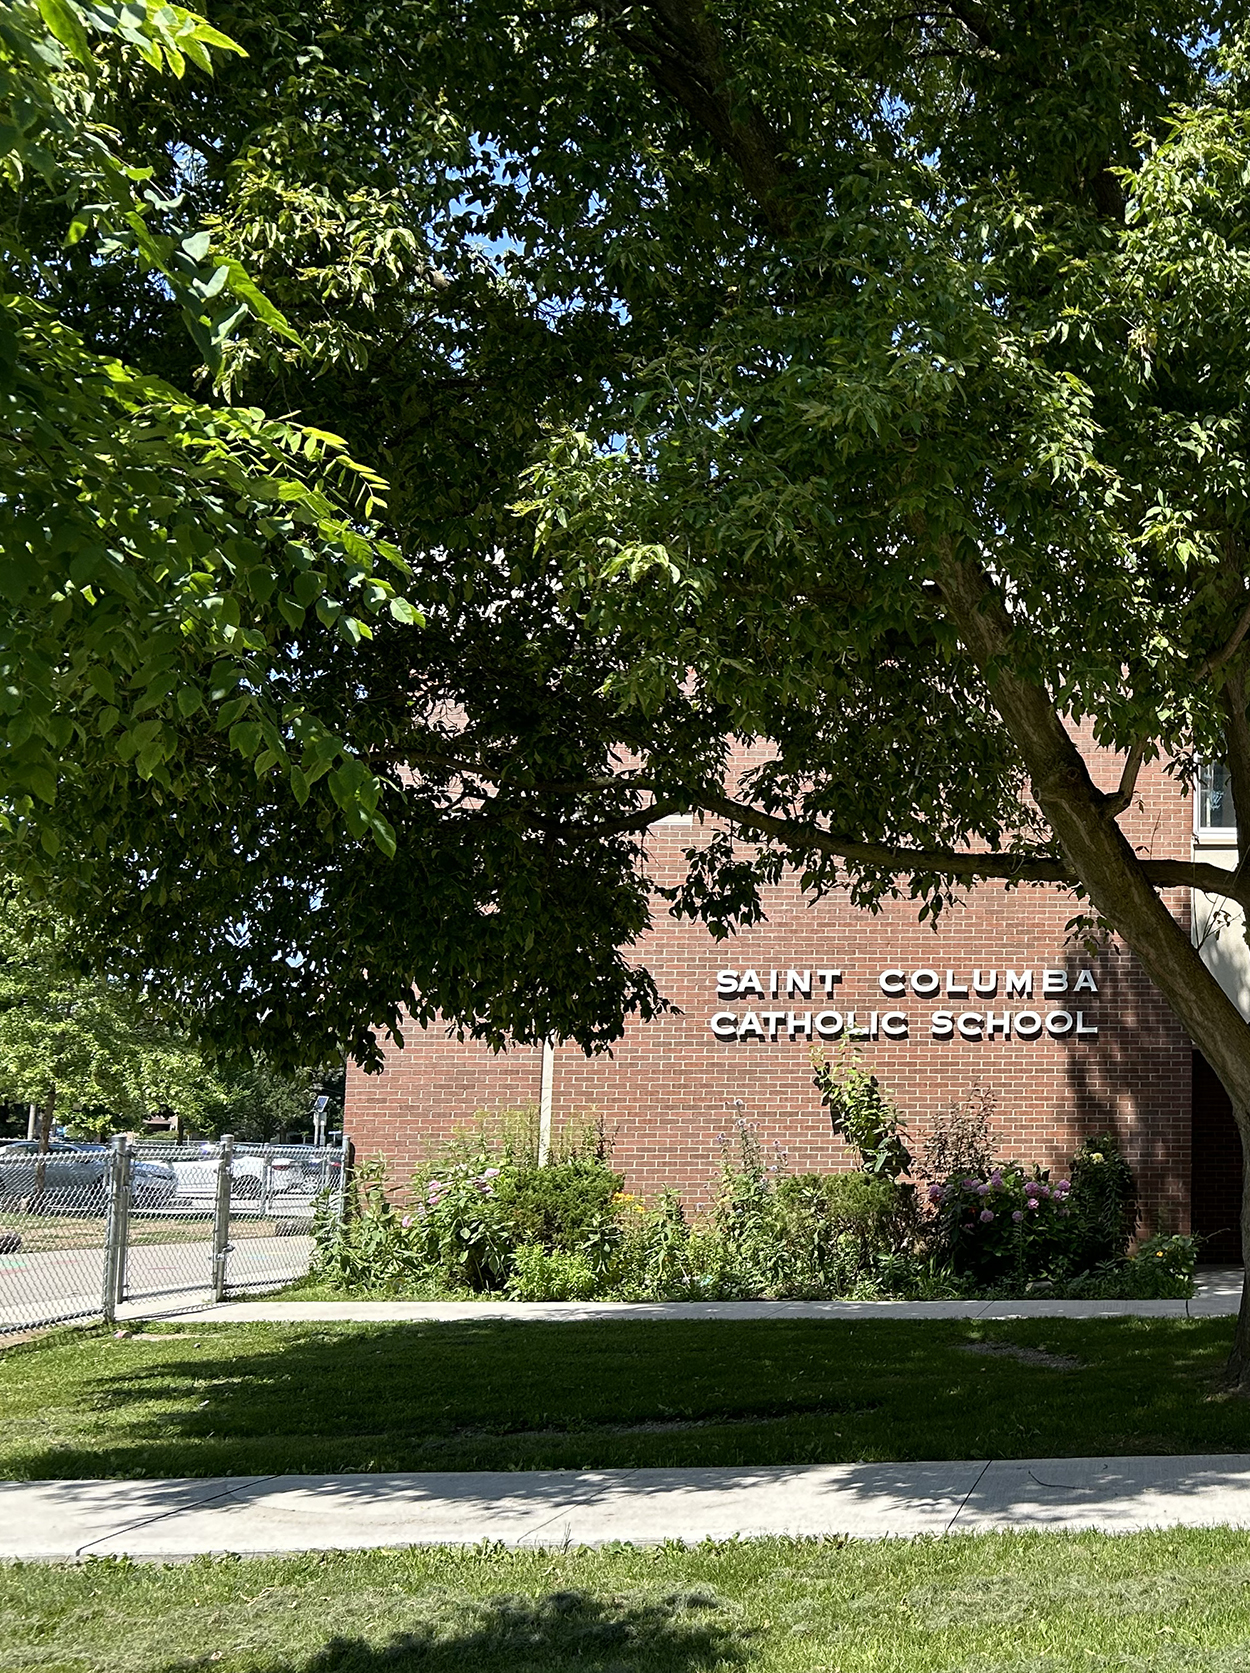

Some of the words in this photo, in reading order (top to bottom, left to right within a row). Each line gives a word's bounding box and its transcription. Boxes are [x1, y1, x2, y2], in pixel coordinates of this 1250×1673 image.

[715, 969, 841, 993] SAINT
[879, 969, 1099, 993] COLUMBA
[710, 1011, 908, 1035] CATHOLIC
[931, 1011, 1099, 1035] SCHOOL
